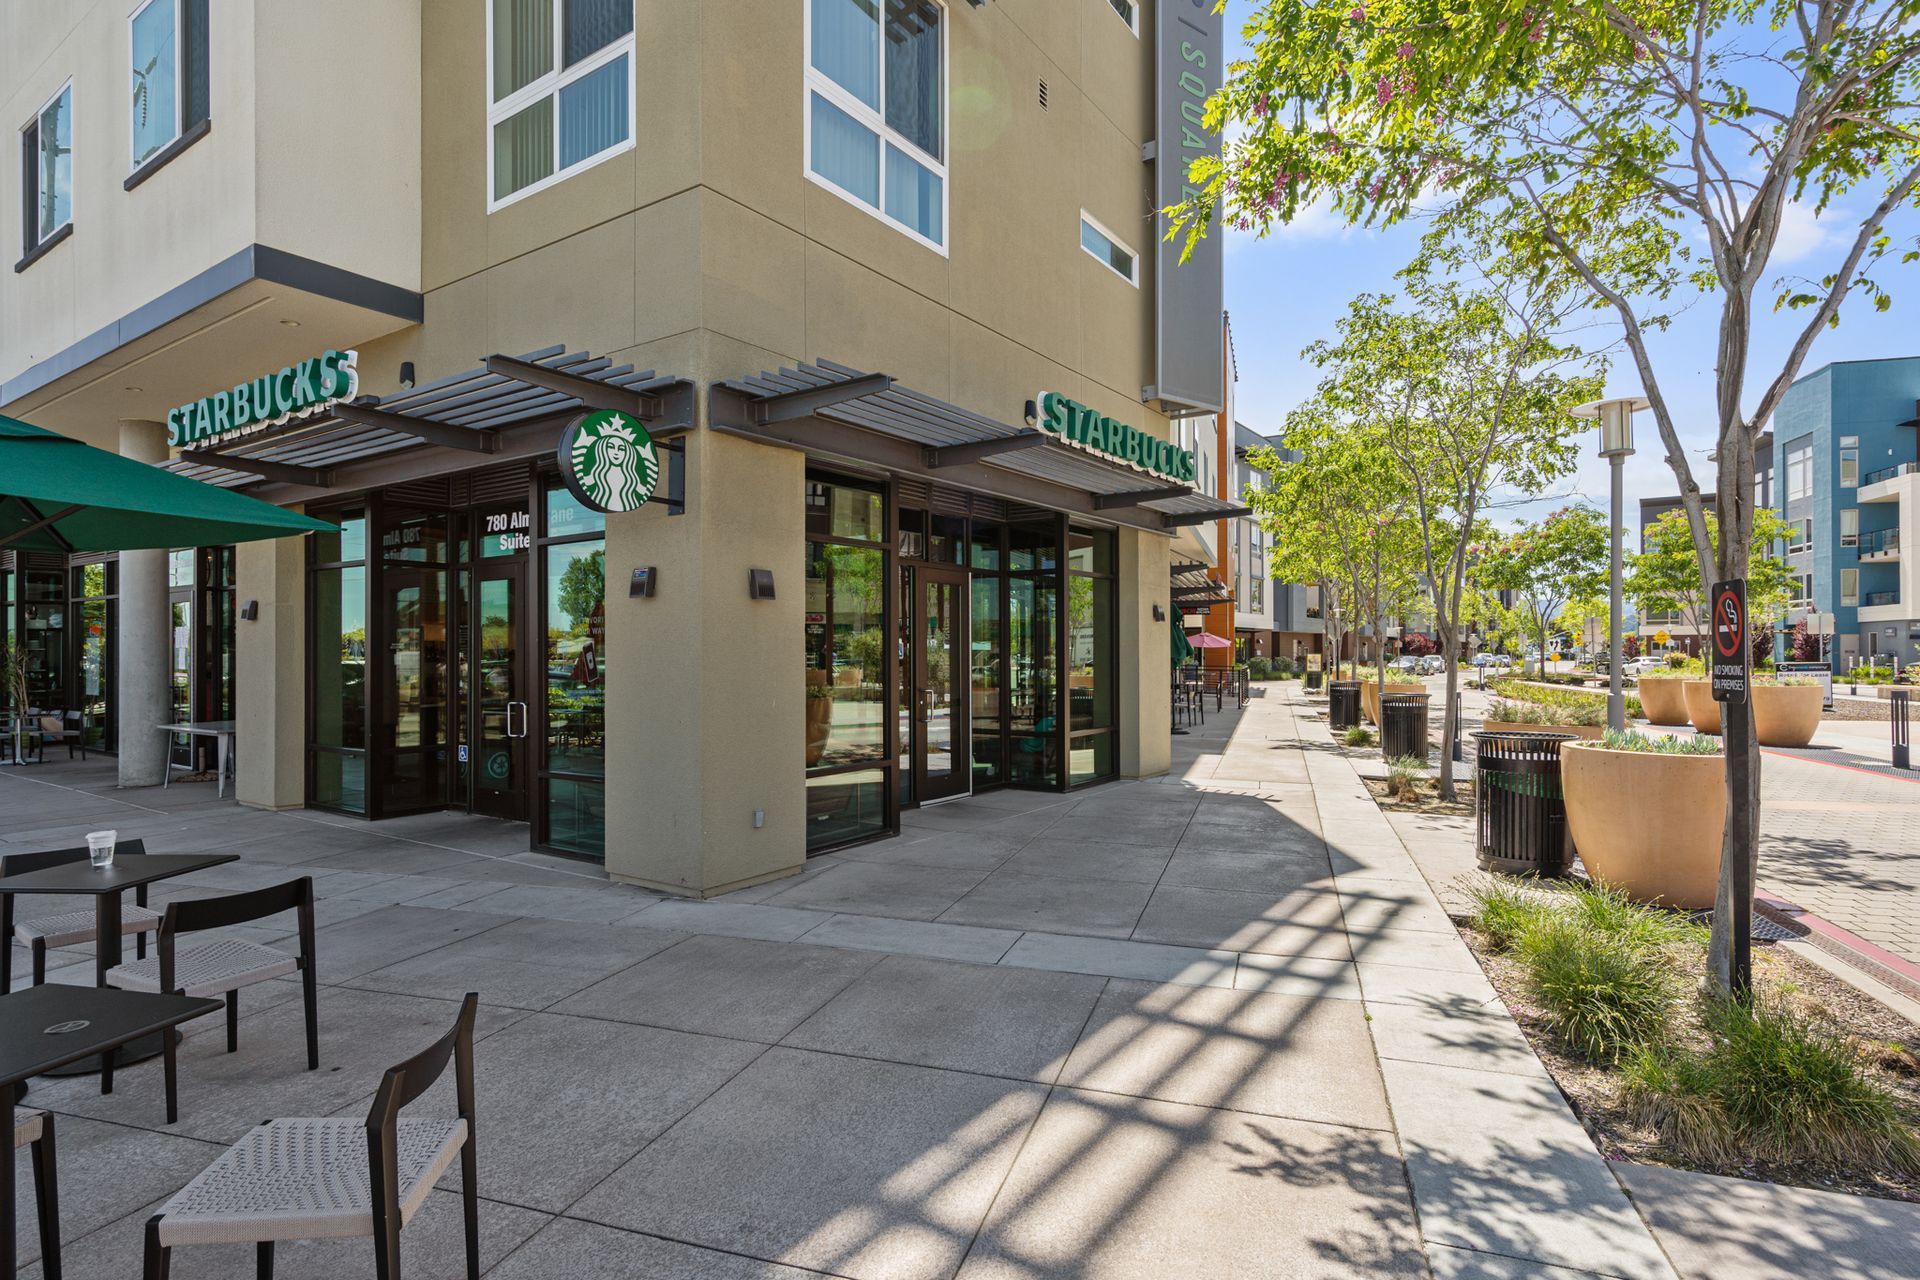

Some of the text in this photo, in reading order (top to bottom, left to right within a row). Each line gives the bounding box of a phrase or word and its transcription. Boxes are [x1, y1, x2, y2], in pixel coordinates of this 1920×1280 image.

[167, 349, 347, 448] STARBUCKS
[1042, 390, 1196, 482] STARBUCKS
[486, 513, 507, 532] 780
[500, 533, 530, 551] Suite
[1714, 664, 1743, 676] NO SMOKING
[1714, 679, 1744, 691] ON PREMISES
